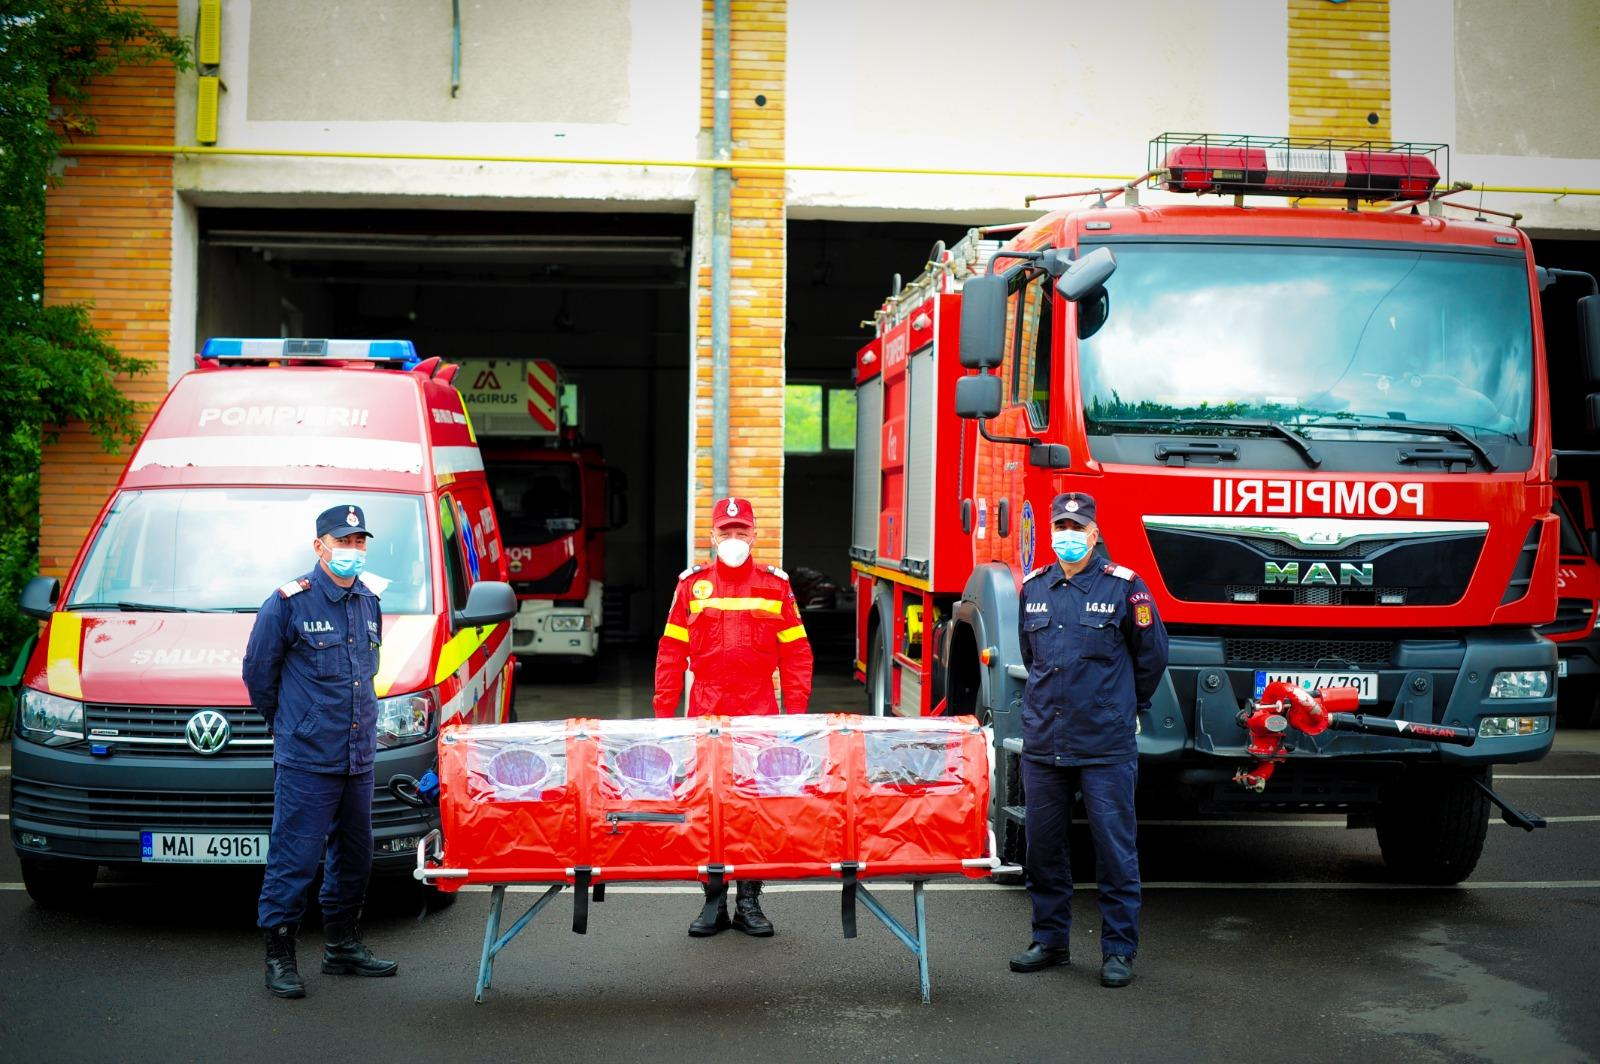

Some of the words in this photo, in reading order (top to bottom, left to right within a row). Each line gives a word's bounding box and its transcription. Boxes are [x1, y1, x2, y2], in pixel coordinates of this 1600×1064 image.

[1264, 561, 1373, 585] MAN
[143, 847, 152, 855] RO
[162, 836, 193, 856] MAI
[207, 837, 260, 857] 49161
